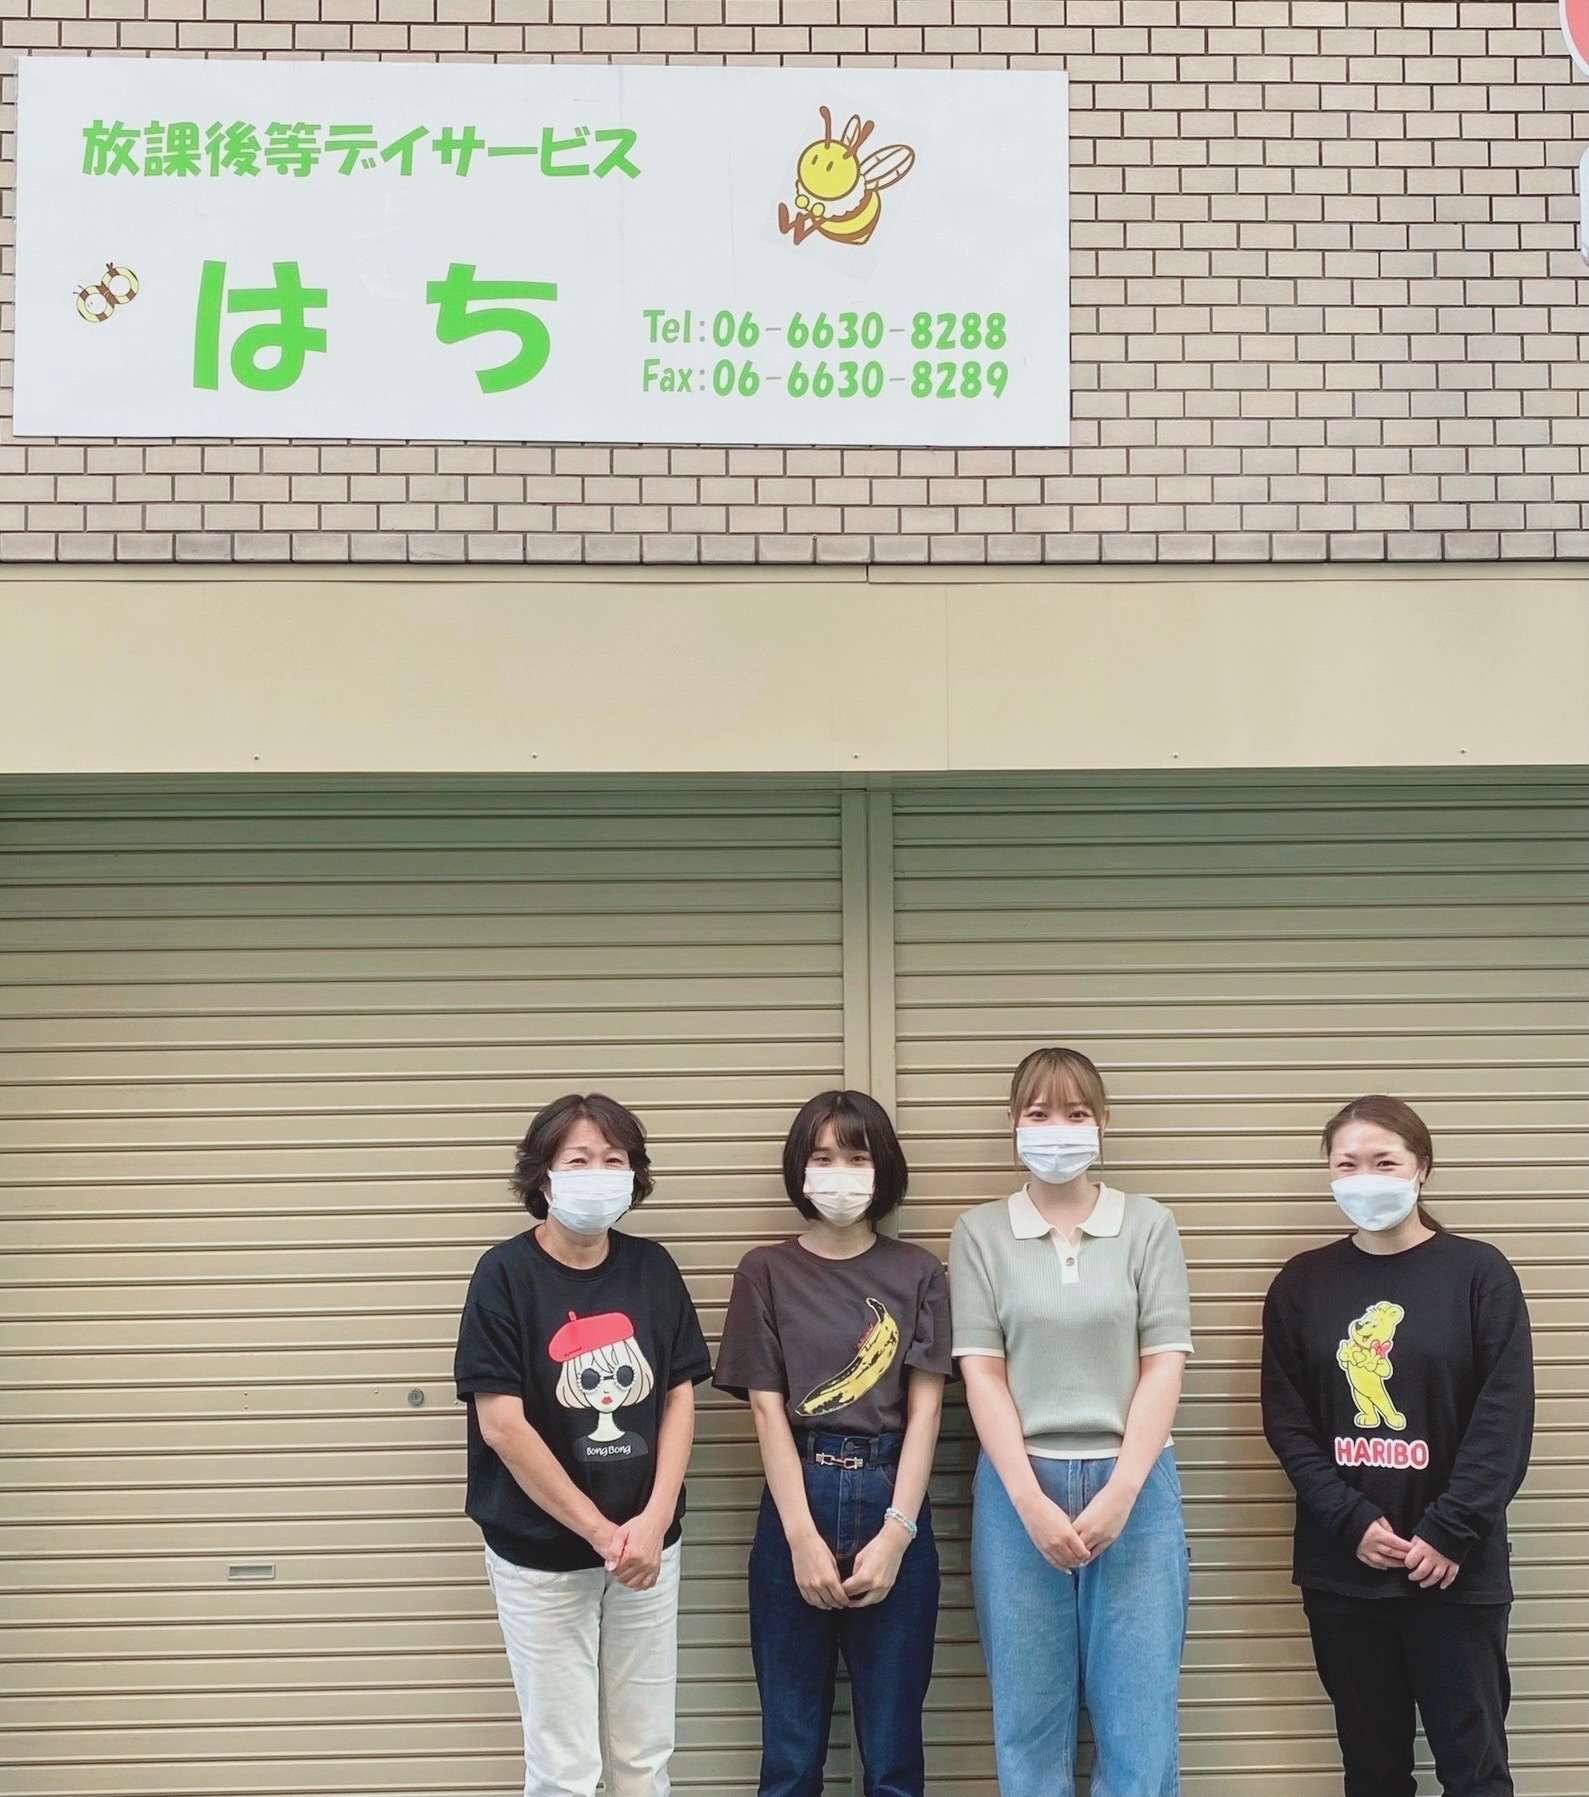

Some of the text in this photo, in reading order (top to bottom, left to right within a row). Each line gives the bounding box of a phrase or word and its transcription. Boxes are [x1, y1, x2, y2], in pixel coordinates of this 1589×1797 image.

[82, 120, 641, 179] 放課後等デイサービス
[1335, 1436, 1430, 1470] HARIBO
